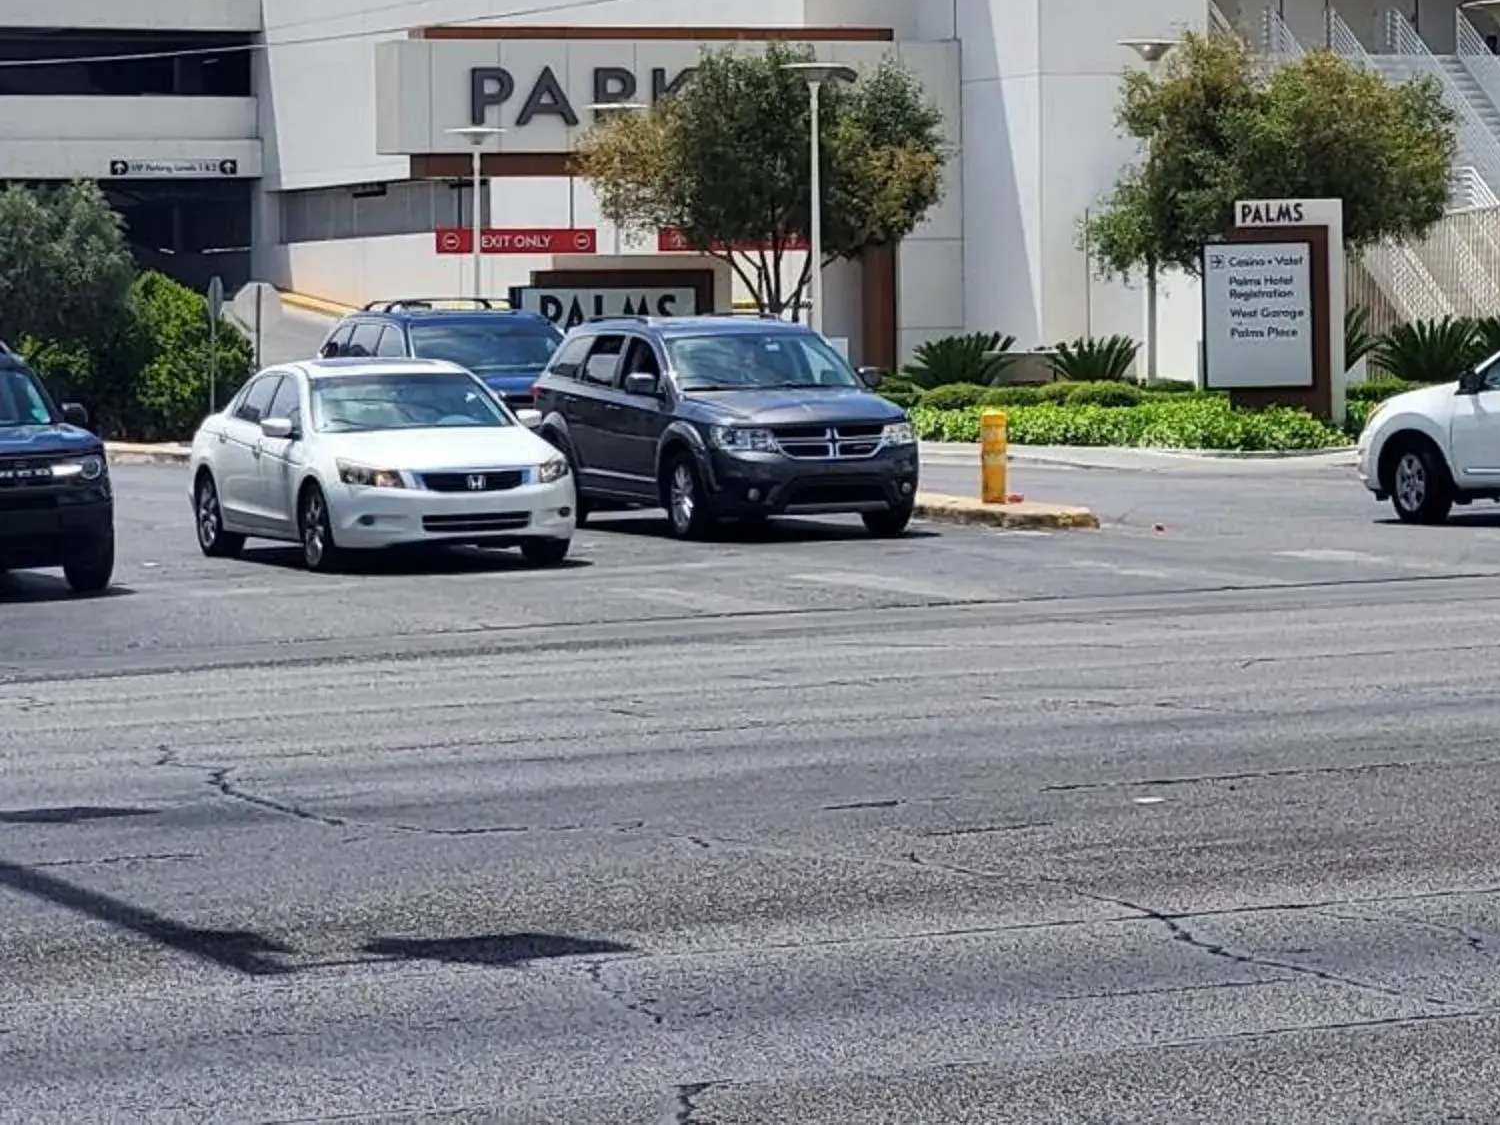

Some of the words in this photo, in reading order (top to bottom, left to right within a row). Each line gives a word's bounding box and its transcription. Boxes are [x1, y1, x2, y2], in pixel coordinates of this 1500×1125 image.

[1240, 202, 1304, 224] PALMS
[481, 235, 511, 248] EXIT
[513, 235, 552, 248] ONLY
[1228, 255, 1266, 267] Casino
[1274, 255, 1304, 266] Valet
[1228, 276, 1262, 286] Palms
[1264, 275, 1294, 286] Hotel
[1229, 289, 1294, 302] Registration
[1230, 308, 1258, 318] West
[1260, 308, 1305, 320] Garage
[1230, 327, 1265, 338] Palms
[1267, 327, 1299, 338] Place
